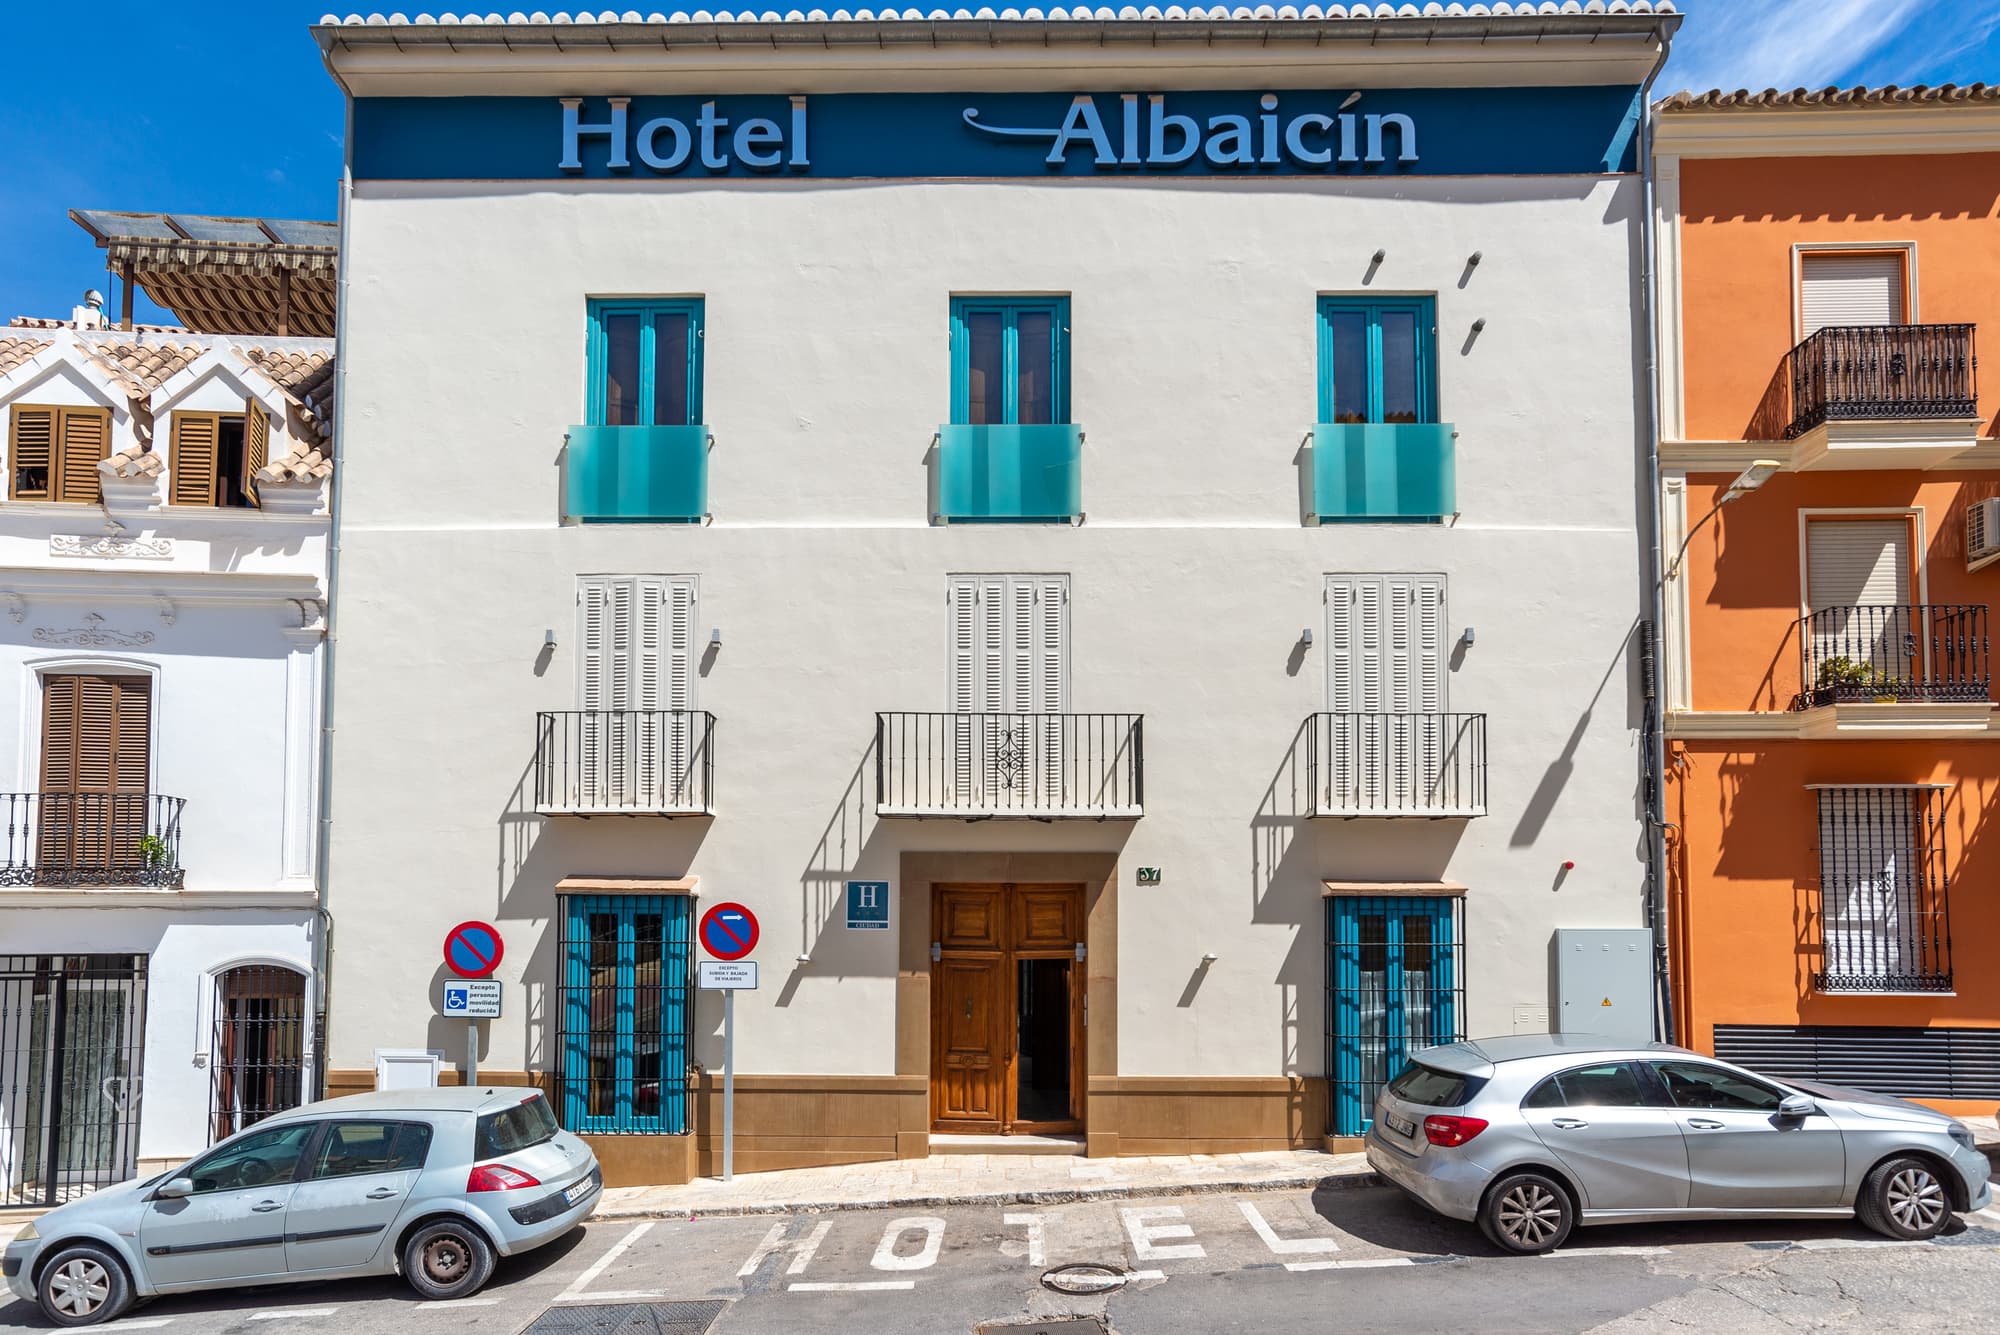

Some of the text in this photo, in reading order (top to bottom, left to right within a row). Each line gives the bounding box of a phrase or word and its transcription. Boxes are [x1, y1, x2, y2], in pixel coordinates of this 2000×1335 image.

[557, 90, 1420, 169] Hotel Albaicín
[857, 885, 880, 908] H
[736, 1201, 1341, 1276] HOTEL
